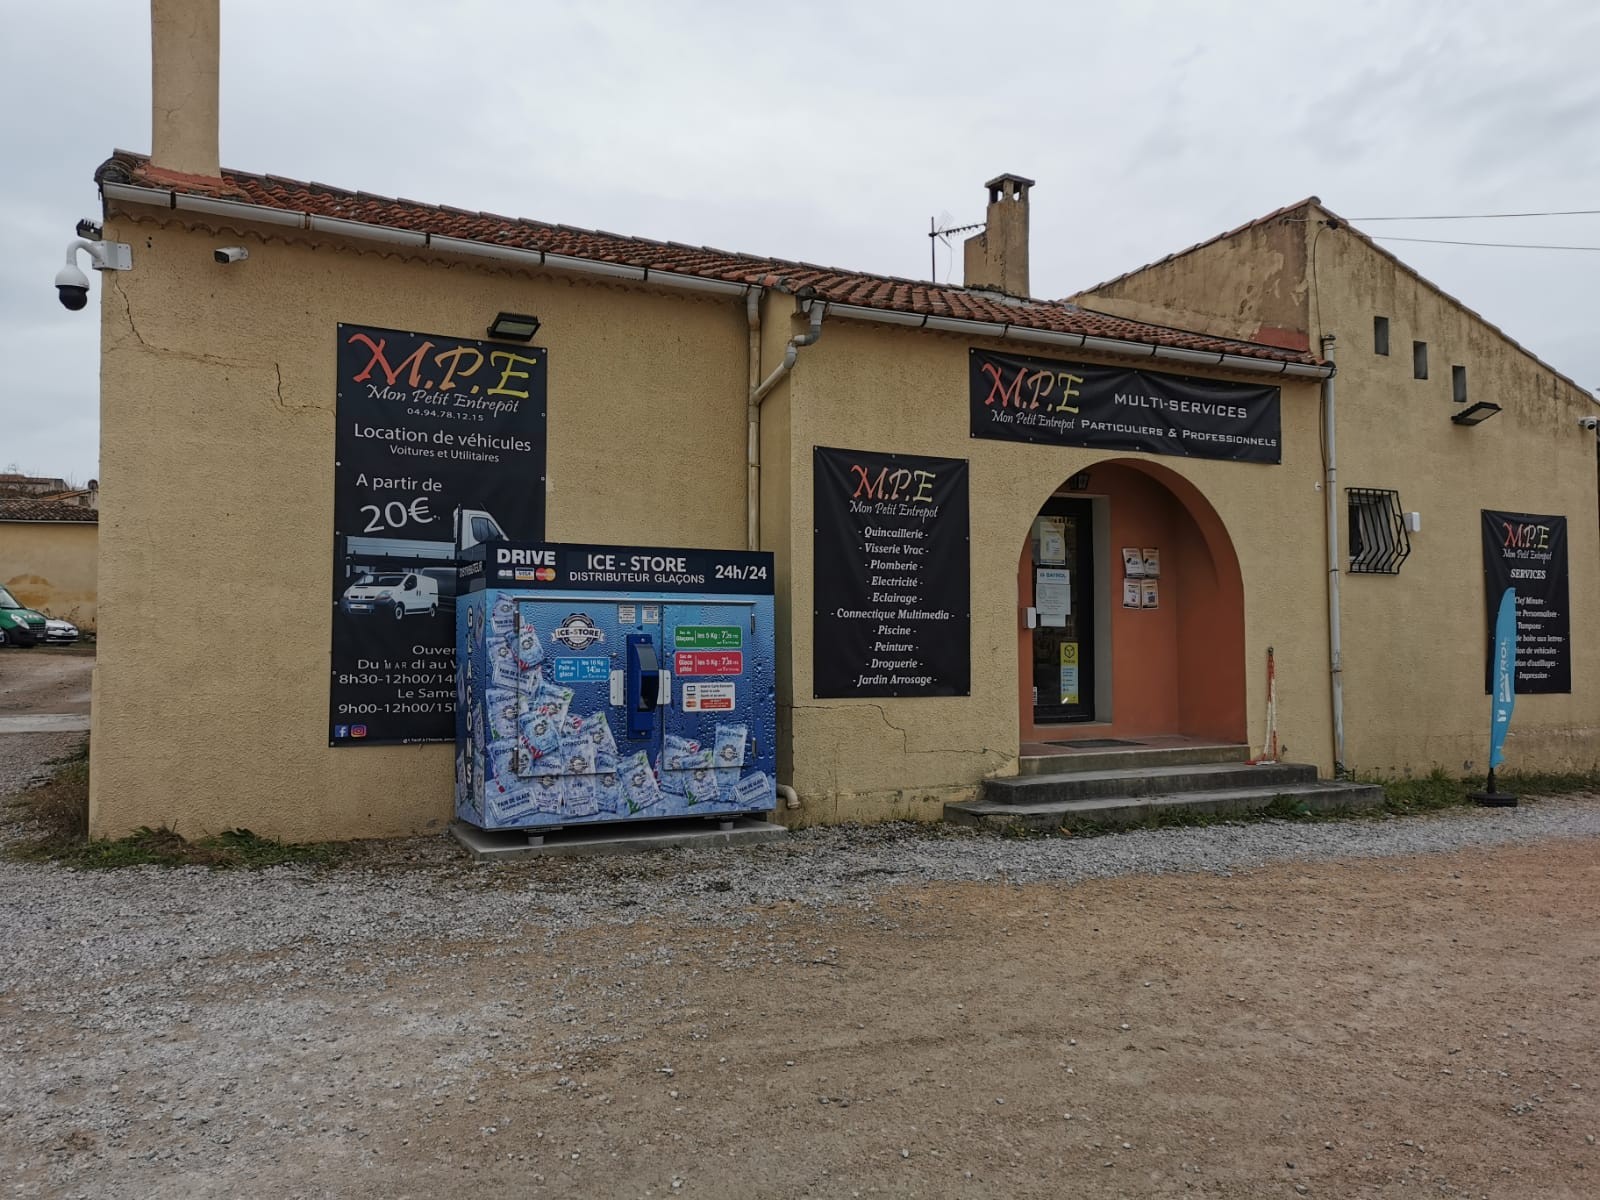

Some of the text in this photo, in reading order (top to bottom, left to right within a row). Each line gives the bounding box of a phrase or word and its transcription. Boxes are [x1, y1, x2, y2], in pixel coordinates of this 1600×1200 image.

[347, 333, 537, 399] M.P.E
[981, 362, 1084, 414] M.P.E
[367, 384, 519, 418] Mon Petit Entrepôt
[1113, 392, 1248, 419] MULTI-SERVICES
[407, 407, 484, 422] 04.94.78.12.15
[991, 409, 1014, 423] Mon
[1015, 410, 1036, 425] Petit
[354, 423, 531, 452] Location de véhicules
[1081, 420, 1277, 447] PARTICULIERS & PROFESSIONNELS
[390, 445, 499, 463] Voitures et Utilitaires
[355, 473, 442, 492] A partir de
[850, 464, 936, 502] M.P.E
[849, 500, 872, 514] Mon
[875, 502, 897, 516] Petit
[864, 526, 923, 539] Quincaillerie
[1503, 522, 1550, 549] M.P.E
[864, 543, 924, 555] Visserie Vrac
[497, 548, 556, 566] DRIVE
[587, 554, 615, 571] ICE
[630, 555, 686, 573] STORE
[870, 559, 918, 570] Plomberie
[569, 572, 705, 585] DISTRIBUTEUR GLAÇONS
[714, 564, 768, 580] 24h/24
[1510, 568, 1546, 580] SERVICES
[871, 576, 918, 587] Electricité
[872, 592, 917, 605] Eclairage
[836, 608, 950, 621] Connectique Multimedia
[557, 628, 600, 637] ICE-STORE
[877, 625, 911, 635] Piscine
[874, 641, 913, 652] Peinture
[357, 659, 379, 669] Du
[429, 661, 447, 669] au
[871, 658, 918, 670] Droguerie
[338, 673, 456, 684] 8h30-12h00/14
[857, 674, 932, 687] Jardin Arrosage
[397, 688, 415, 698] Le
[338, 702, 456, 714] 9h00-12h00/15
